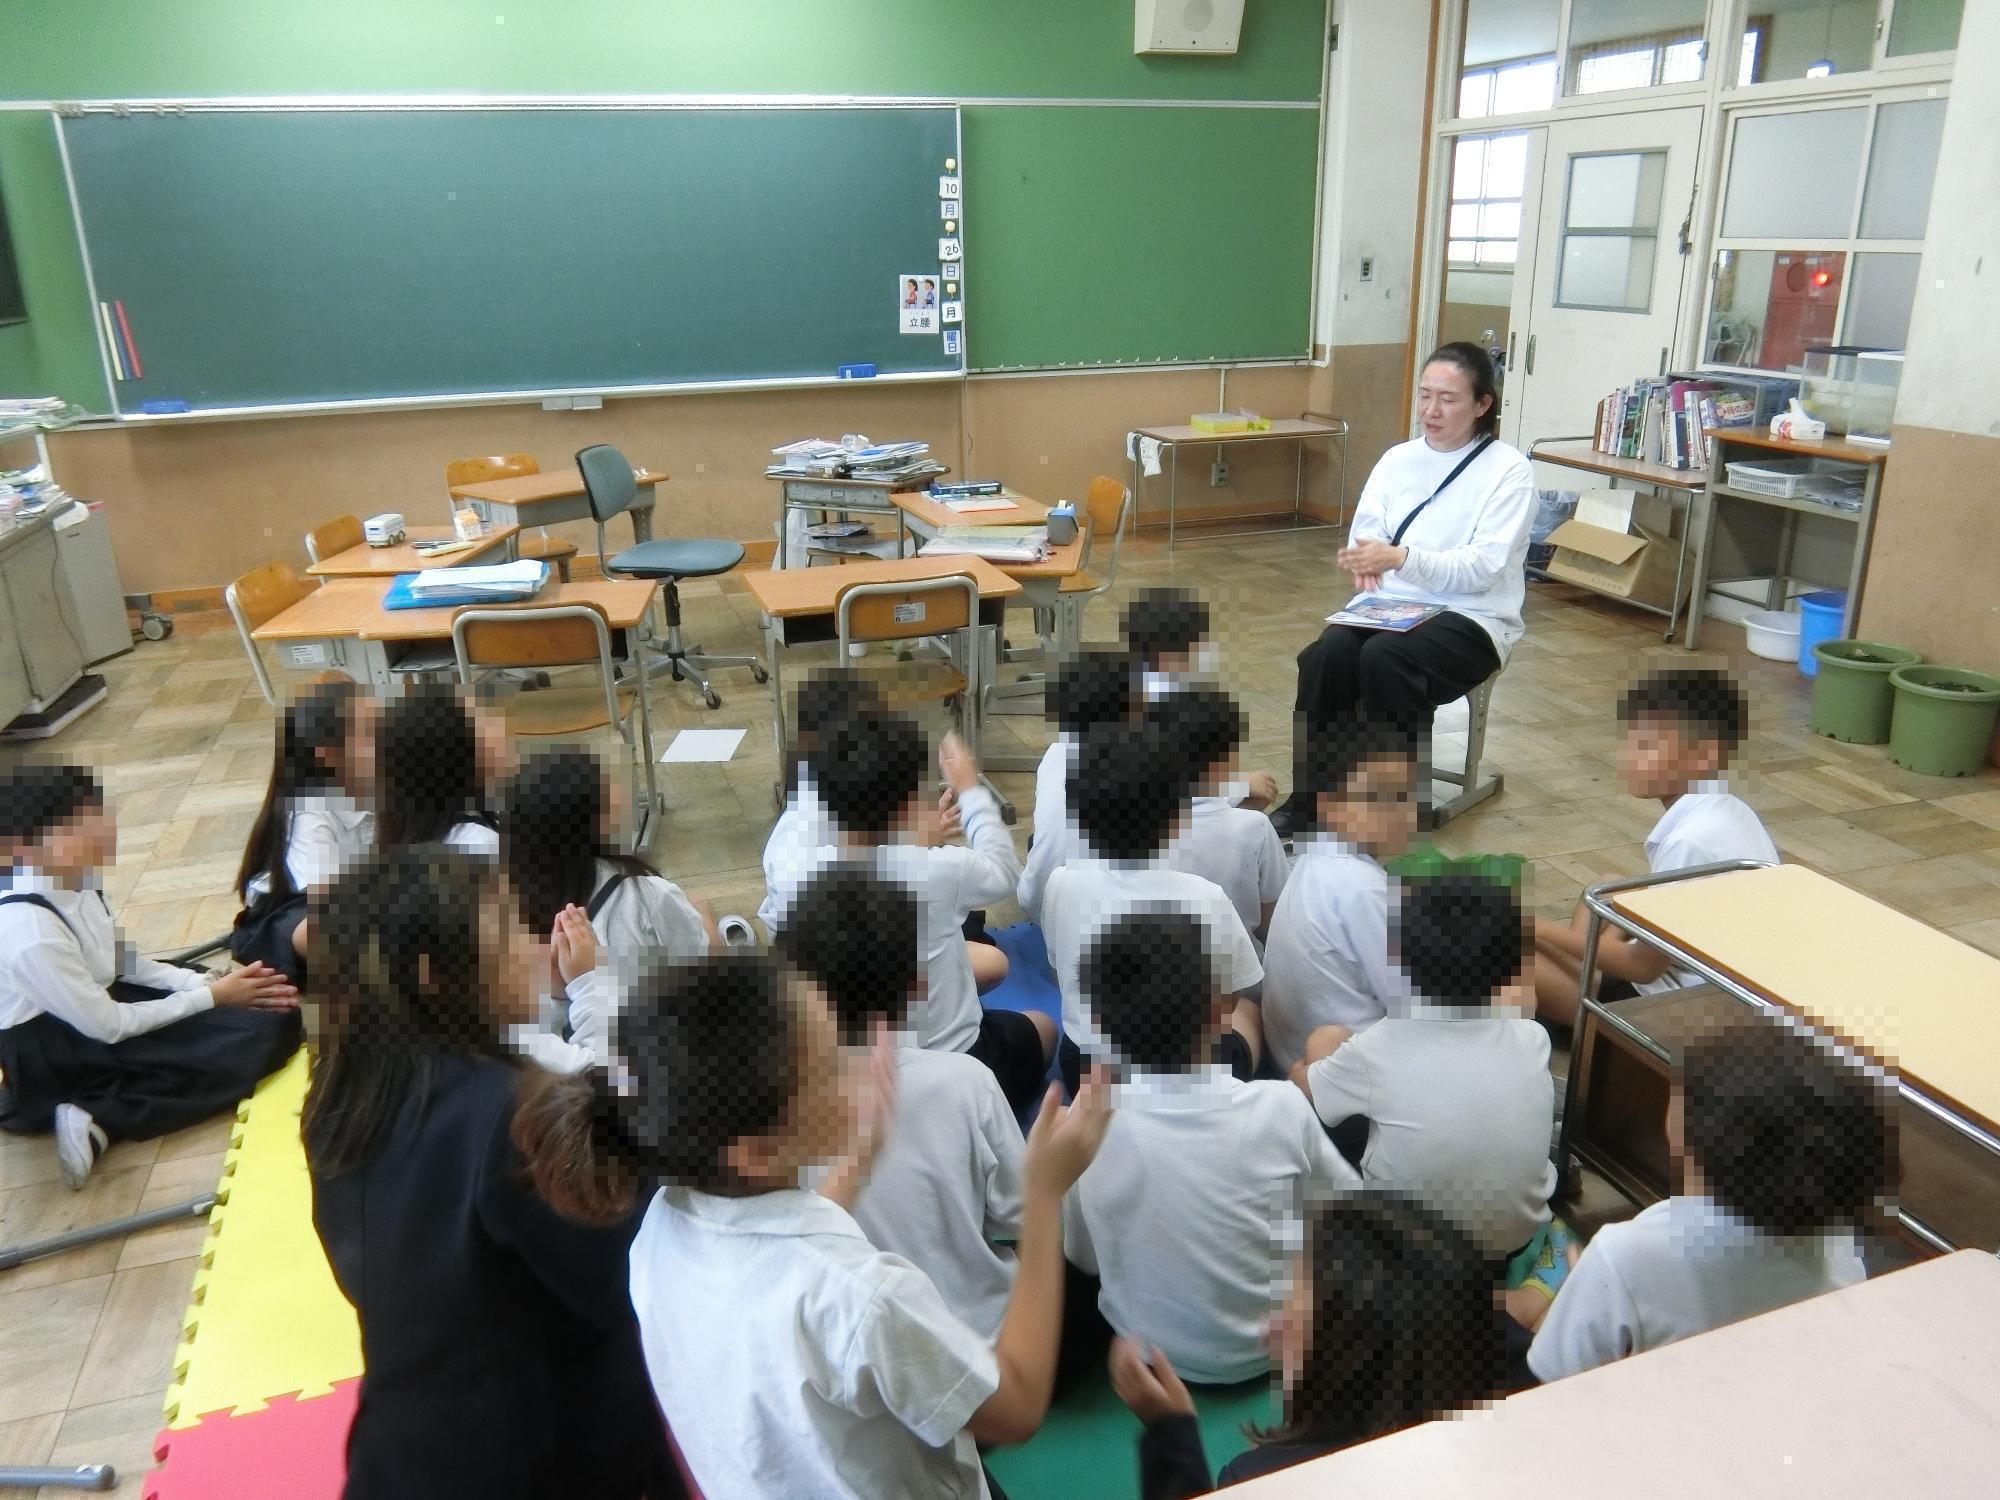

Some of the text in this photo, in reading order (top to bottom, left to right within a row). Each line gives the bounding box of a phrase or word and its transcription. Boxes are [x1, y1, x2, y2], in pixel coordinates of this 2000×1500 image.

[945, 183, 957, 194] 10
[945, 204, 955, 215] 月
[946, 266, 956, 277] 日
[946, 306, 956, 318] 月
